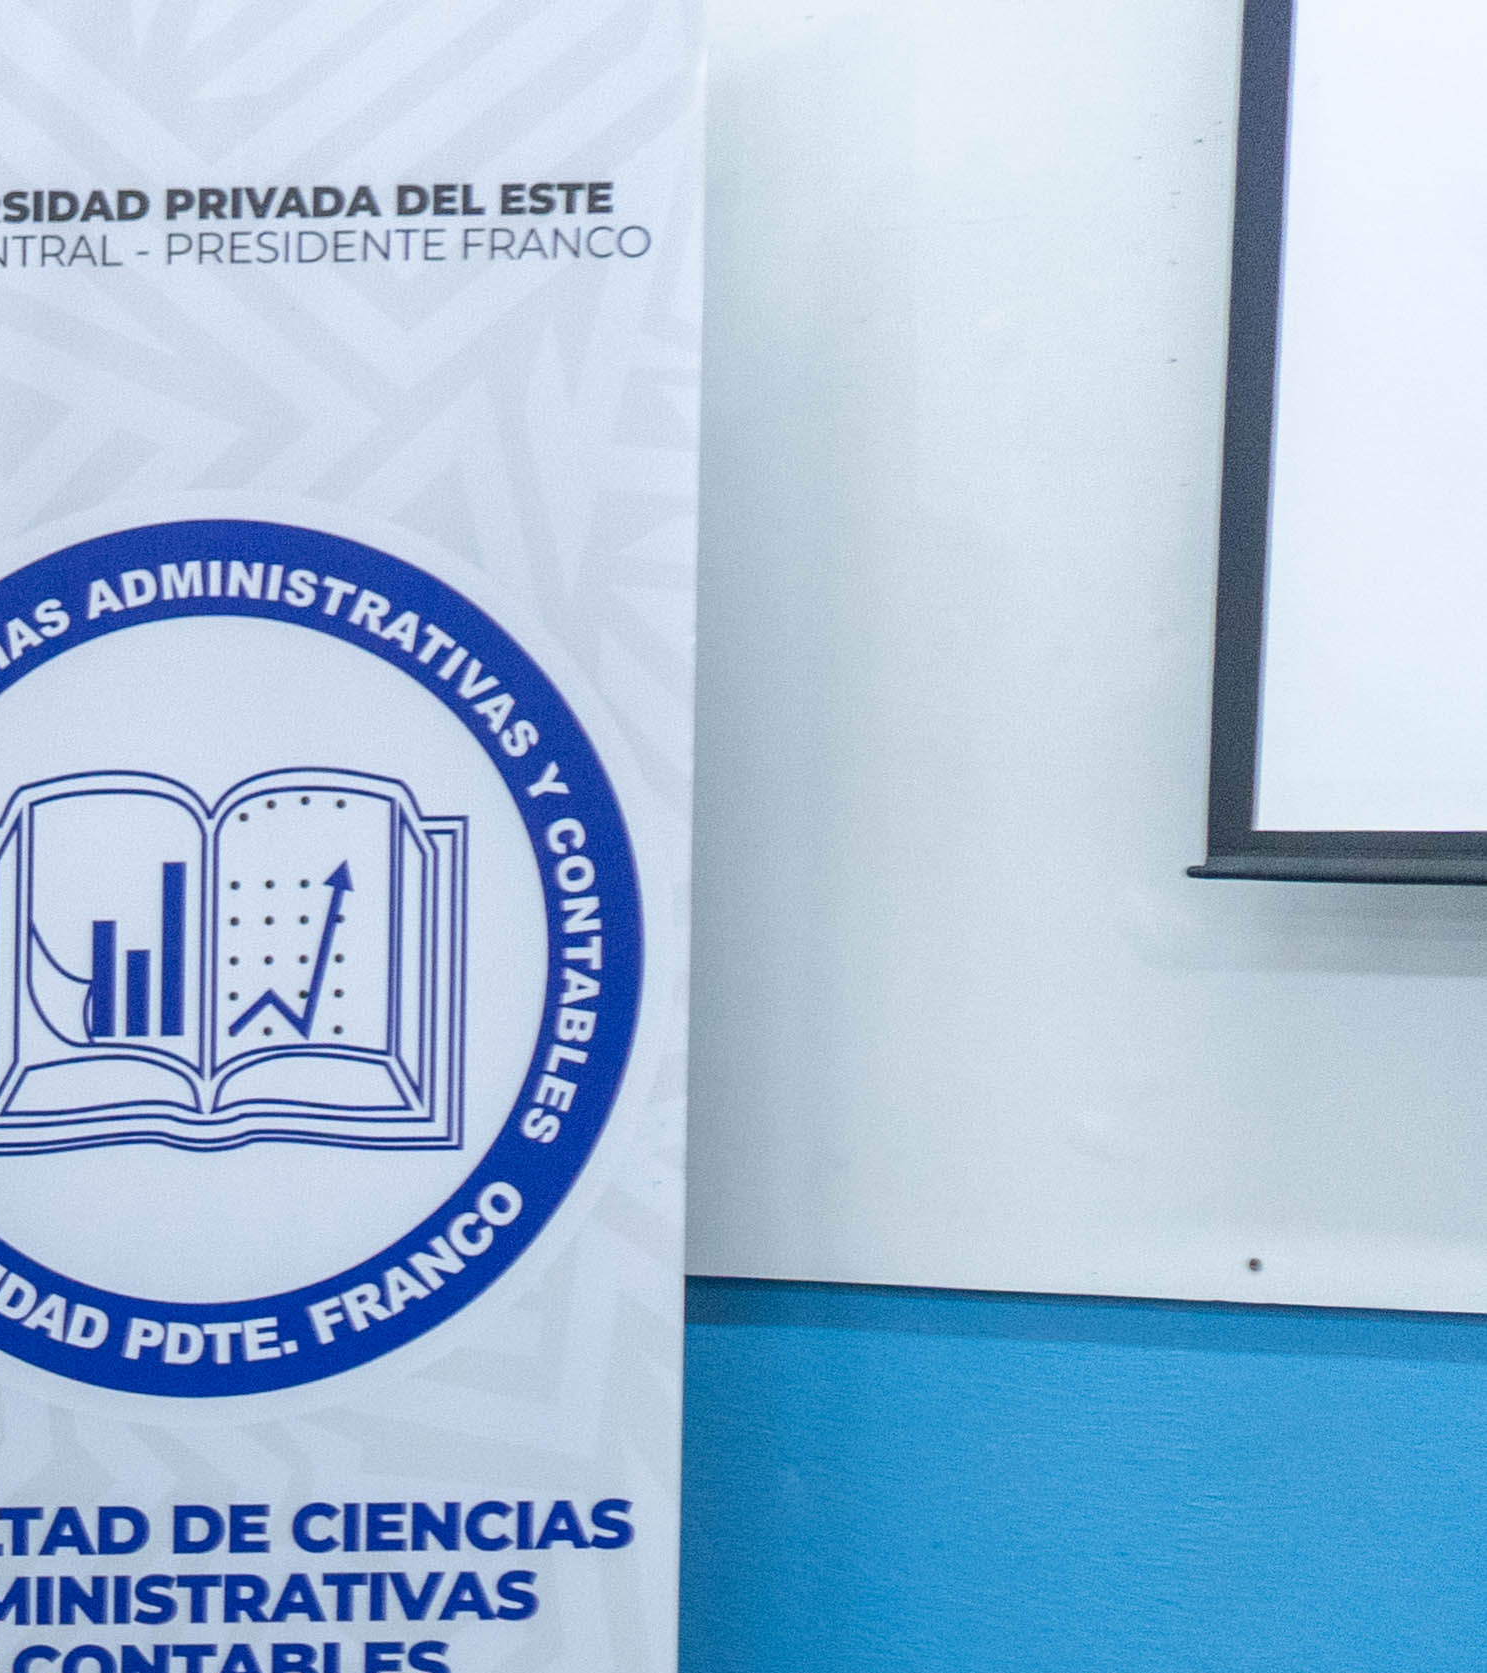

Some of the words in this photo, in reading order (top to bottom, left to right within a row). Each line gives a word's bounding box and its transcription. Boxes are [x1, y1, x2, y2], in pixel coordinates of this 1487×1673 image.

[166, 186, 380, 220] PRIVADA
[397, 184, 485, 216] DEL
[501, 182, 612, 215] ESTE
[167, 229, 446, 264] PRESIDENTE
[462, 225, 651, 260] FRANCO
[88, 561, 538, 756] ADMINISTRATIVAS
[528, 762, 568, 797] Y
[522, 818, 601, 1142] CONTABLES
[124, 1317, 298, 1364] PDTE.
[309, 1182, 522, 1344] FRANCO
[173, 1505, 269, 1554] DE
[292, 1499, 633, 1553] CIENCIAS
